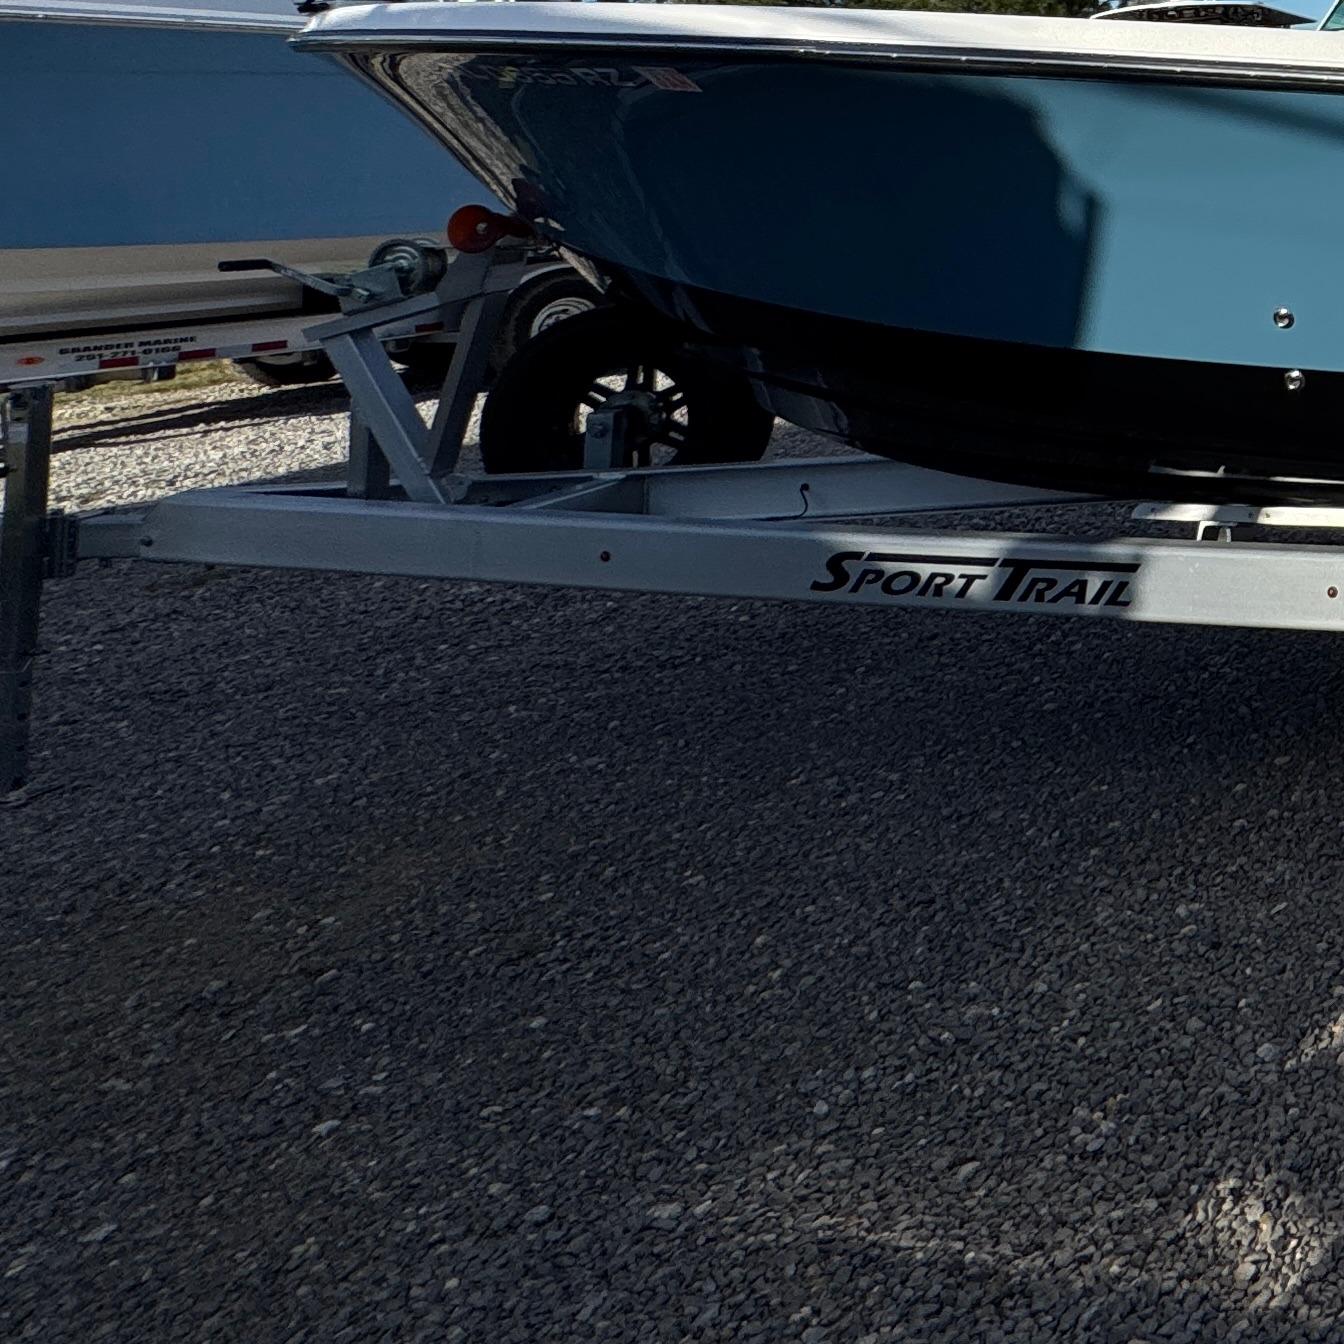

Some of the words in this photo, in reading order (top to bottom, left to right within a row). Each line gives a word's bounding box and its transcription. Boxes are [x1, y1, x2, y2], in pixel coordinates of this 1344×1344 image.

[138, 336, 197, 347] MARINE
[809, 551, 996, 599] SPORT
[993, 558, 1141, 607] TRAIL
